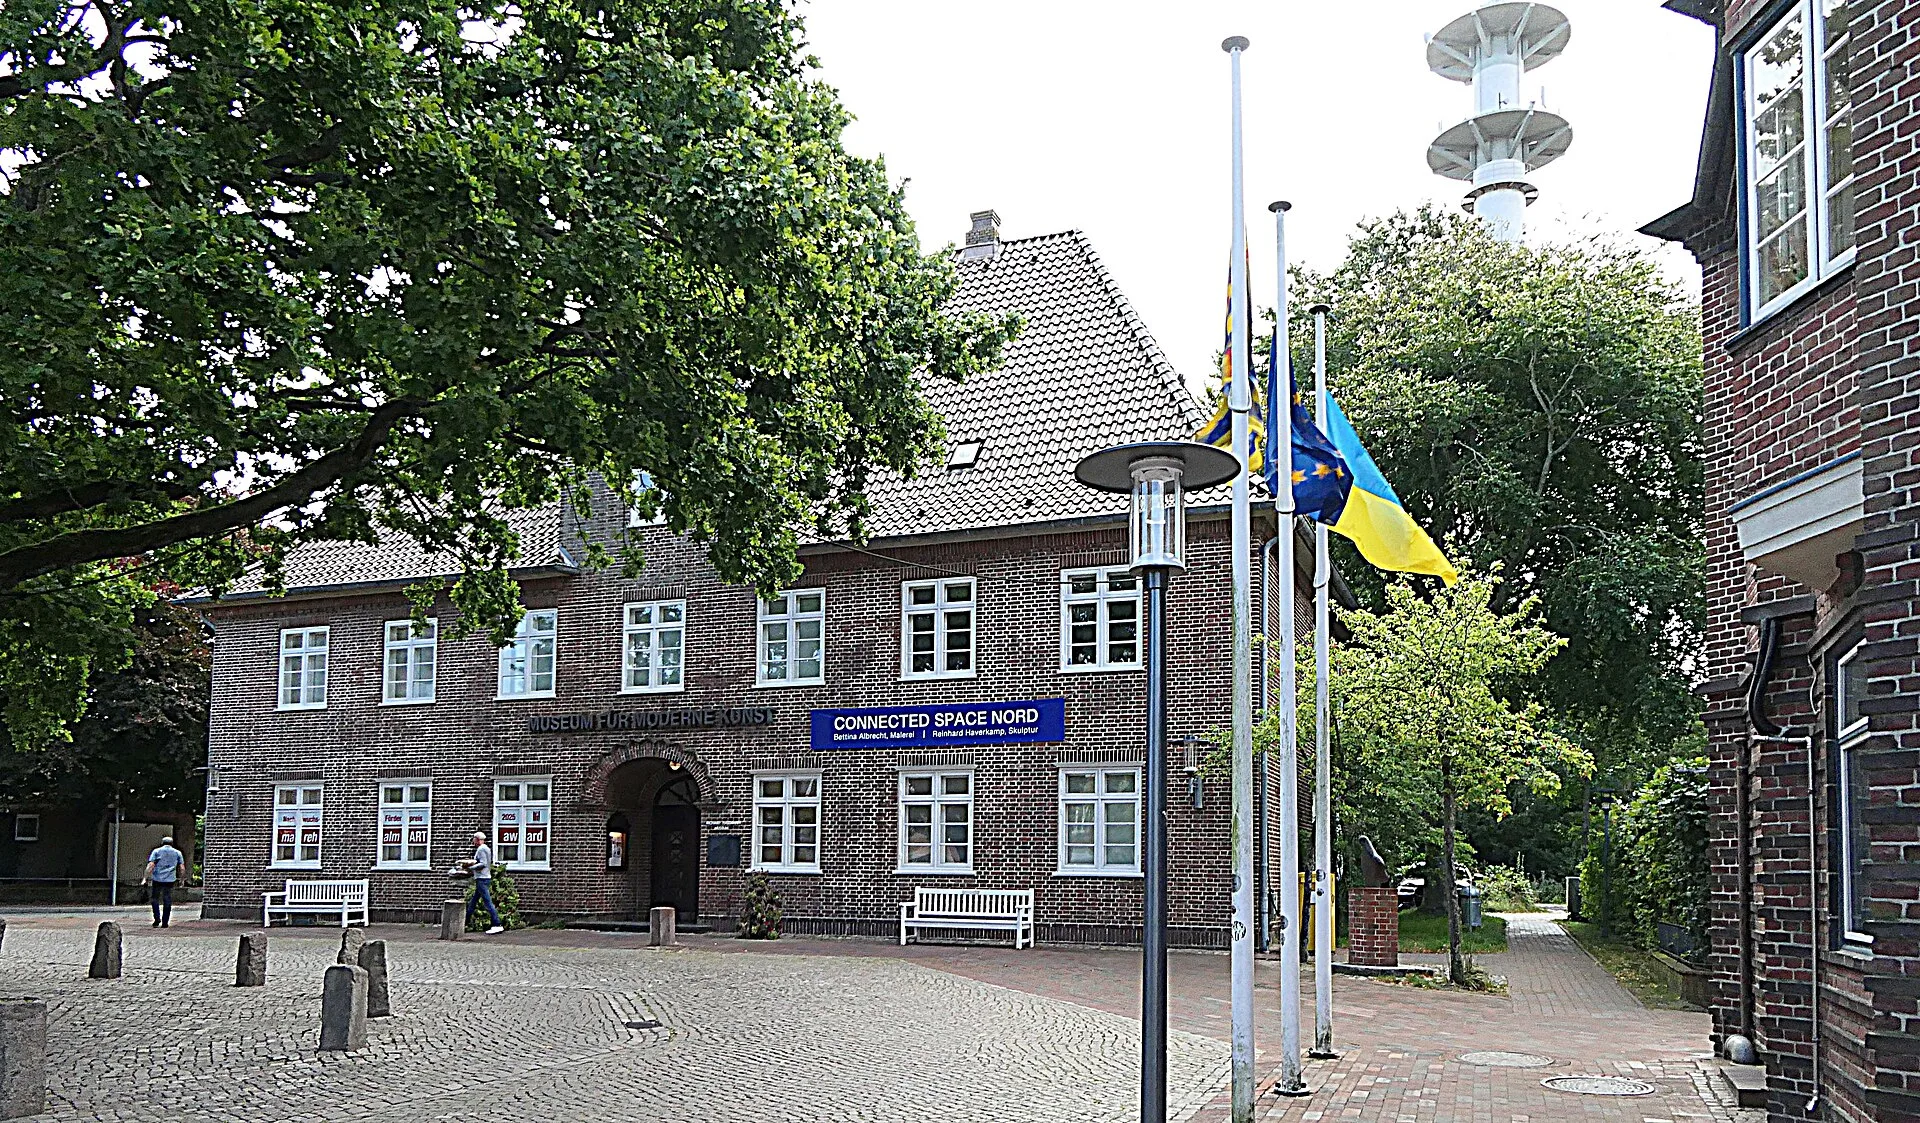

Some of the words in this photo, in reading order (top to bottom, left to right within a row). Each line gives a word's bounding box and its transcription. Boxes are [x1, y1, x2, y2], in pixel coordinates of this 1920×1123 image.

[528, 715, 593, 731] MUSEUM
[635, 709, 716, 728] MODERNE
[719, 707, 774, 725] KUNST
[834, 713, 930, 730] CONNECTED
[934, 711, 987, 727] SPACE
[991, 709, 1039, 725] NORD
[858, 731, 889, 740] Albrecht,
[889, 730, 915, 739] Malerei
[932, 729, 963, 738] Reinhard
[965, 728, 1007, 737] Haverkamp,
[1008, 727, 1039, 735] Skulptur
[281, 833, 294, 842] ma
[303, 831, 318, 843] reh
[383, 831, 400, 842] alm
[409, 831, 427, 842] ART
[503, 832, 518, 842] aw
[527, 829, 543, 842] ard
